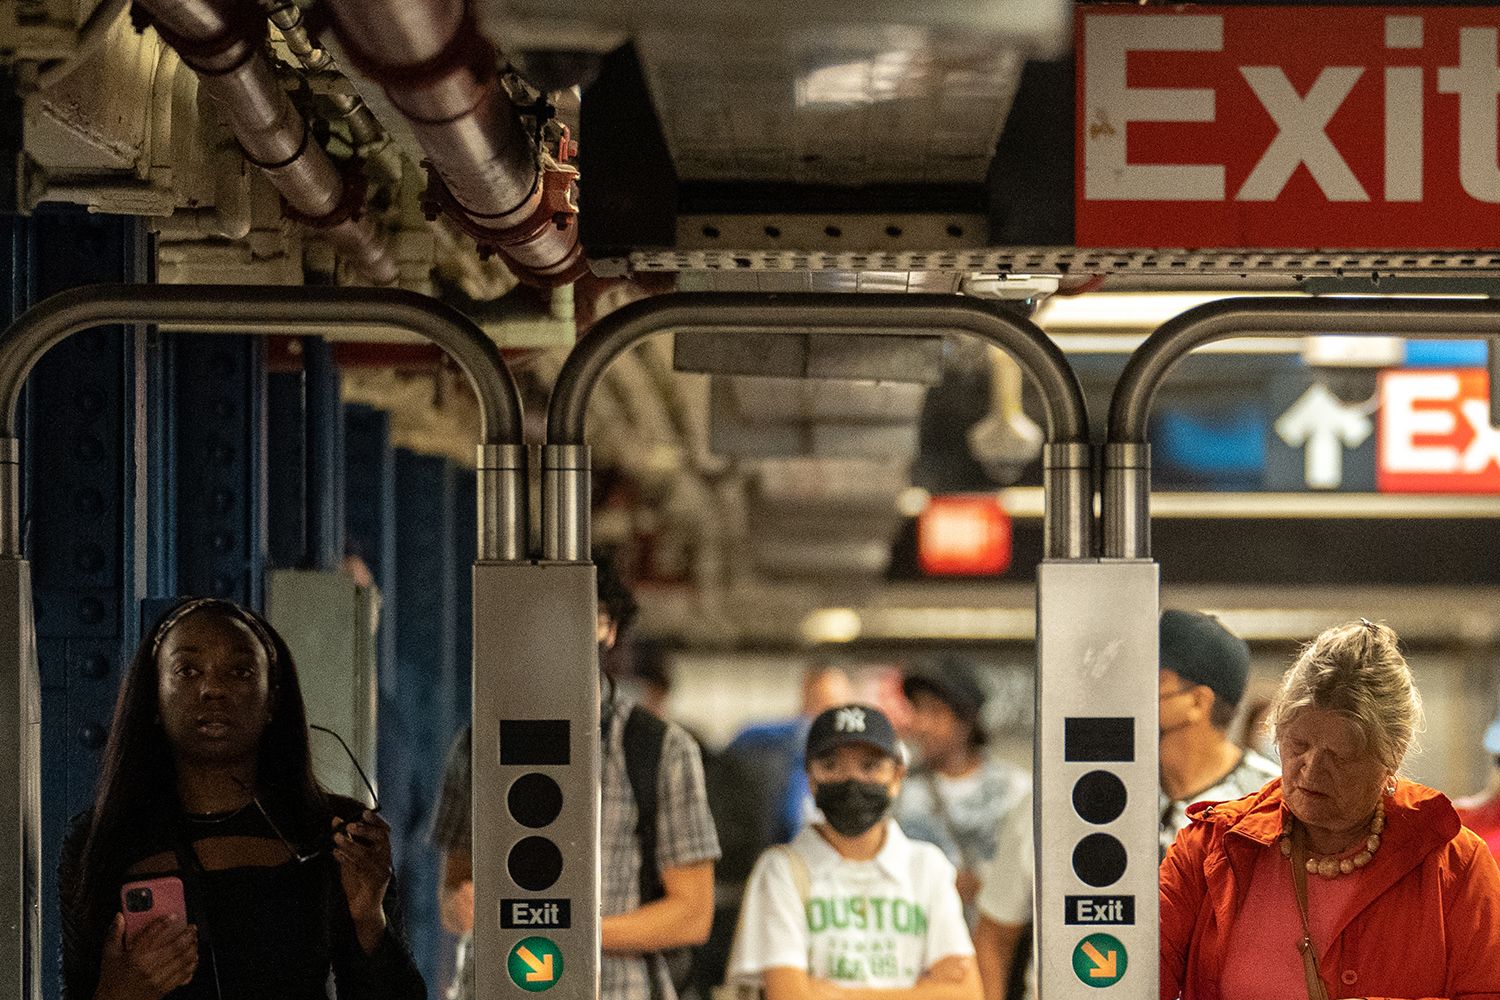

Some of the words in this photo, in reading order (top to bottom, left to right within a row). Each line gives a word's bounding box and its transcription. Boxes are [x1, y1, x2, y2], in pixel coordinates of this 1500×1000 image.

[512, 903, 559, 925] Exit
[807, 895, 928, 936] OUSTON
[1077, 900, 1124, 921] Exit
